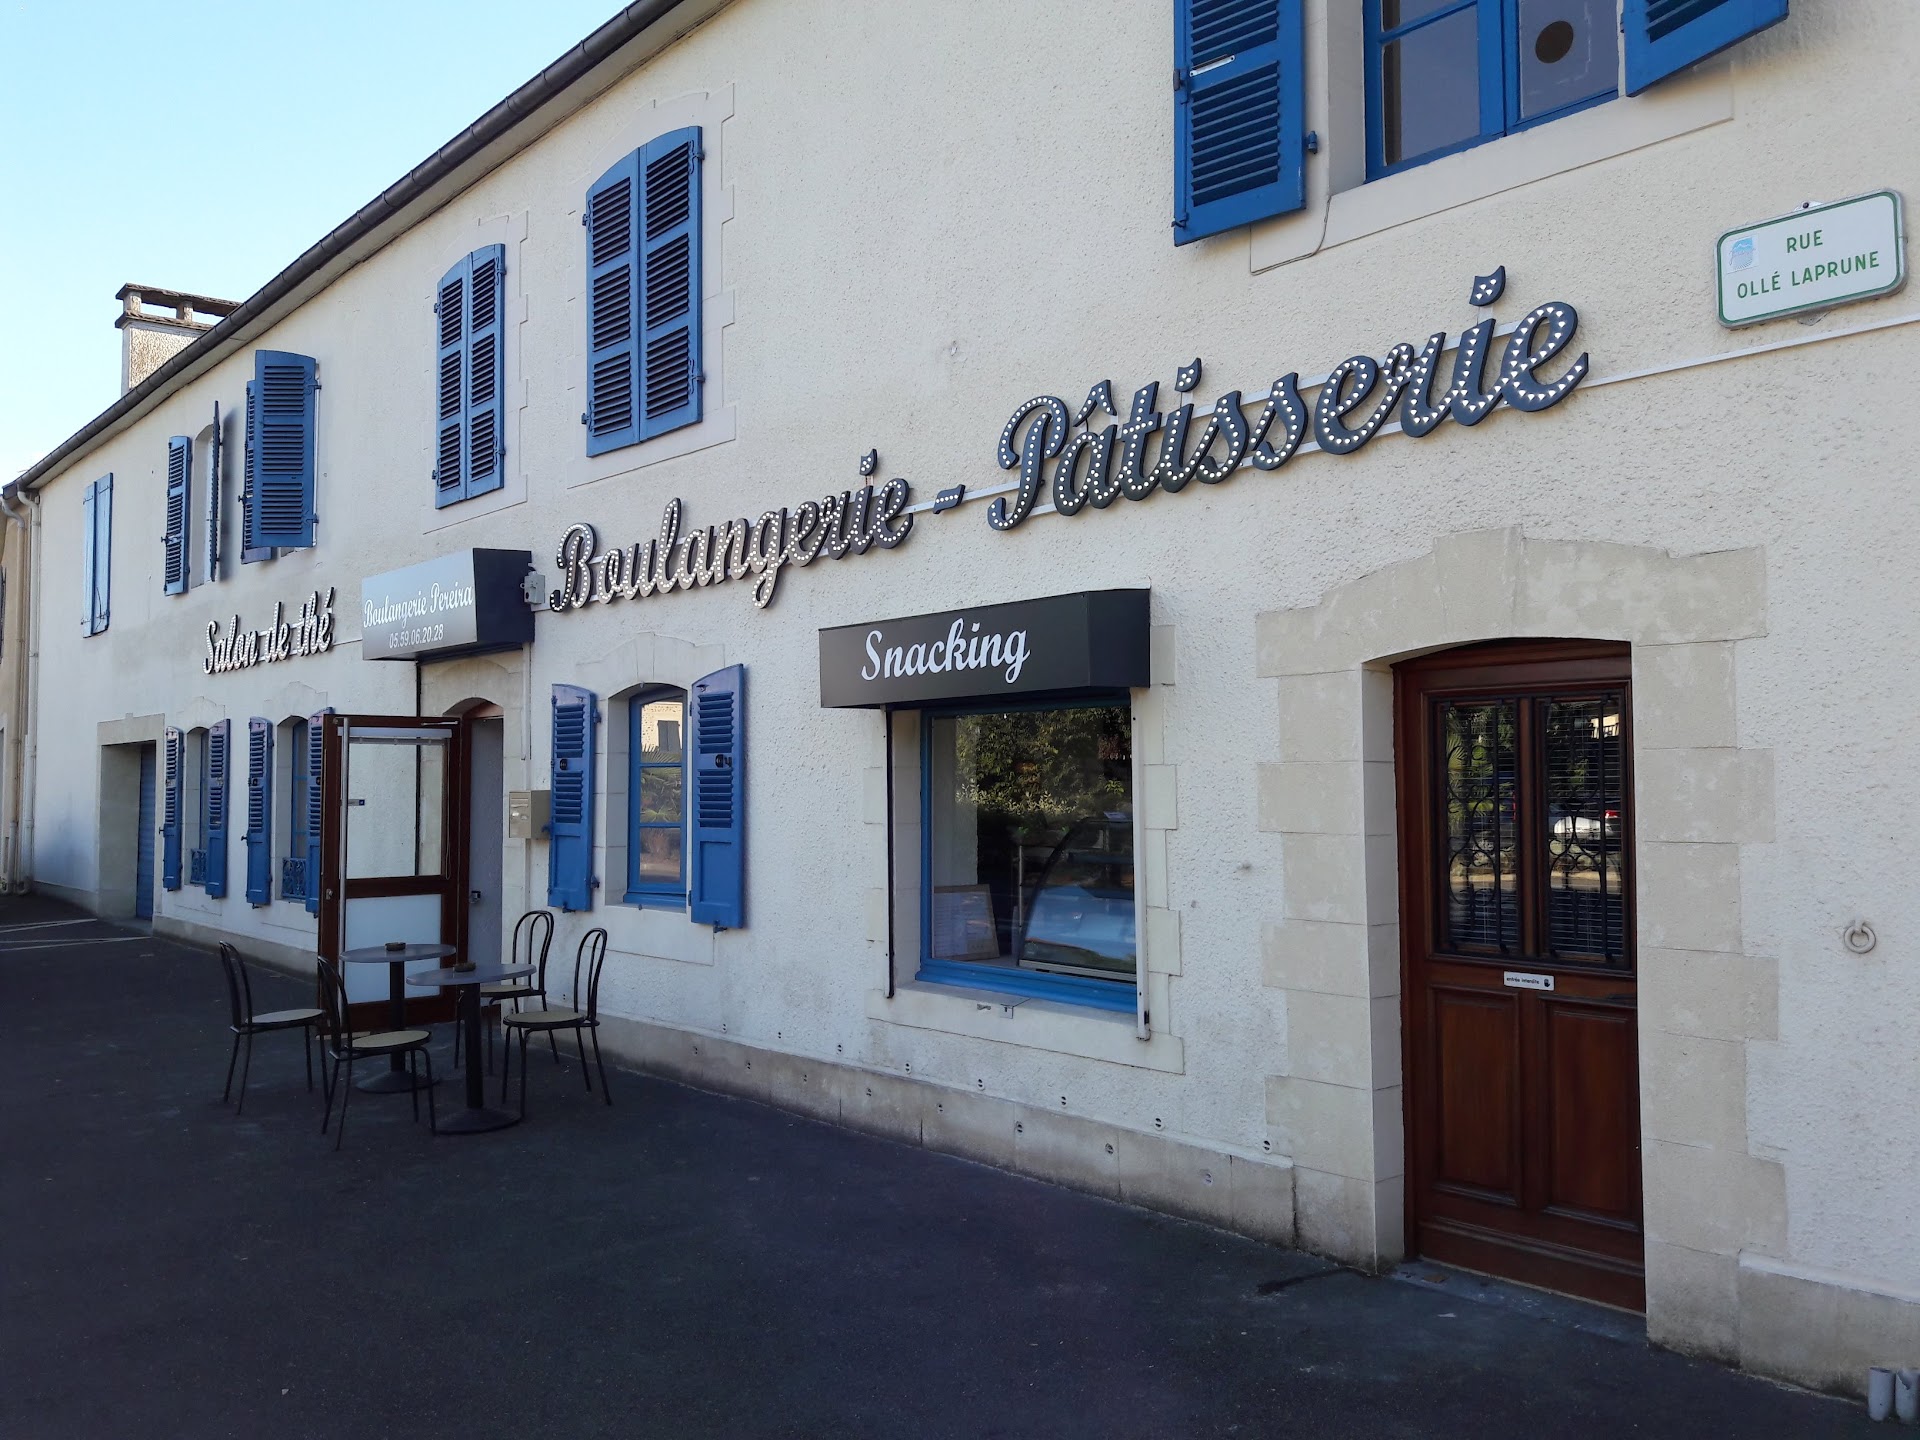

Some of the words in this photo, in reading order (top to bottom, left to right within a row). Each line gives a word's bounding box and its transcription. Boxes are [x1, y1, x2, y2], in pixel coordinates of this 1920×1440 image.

[1786, 229, 1824, 253] RUE
[1737, 271, 1781, 299] OLLÉ
[1791, 251, 1880, 287] LAPRUNE
[549, 448, 914, 613] Boulangerie
[987, 265, 1590, 532] Pâtisserie
[363, 590, 428, 629] Boulangerie
[430, 581, 474, 613] Pereira
[203, 614, 259, 675] Salon
[265, 601, 292, 664] de
[296, 586, 335, 657] thé
[389, 623, 445, 649] 05.59.06.20.28
[861, 617, 1031, 684] Snacking
